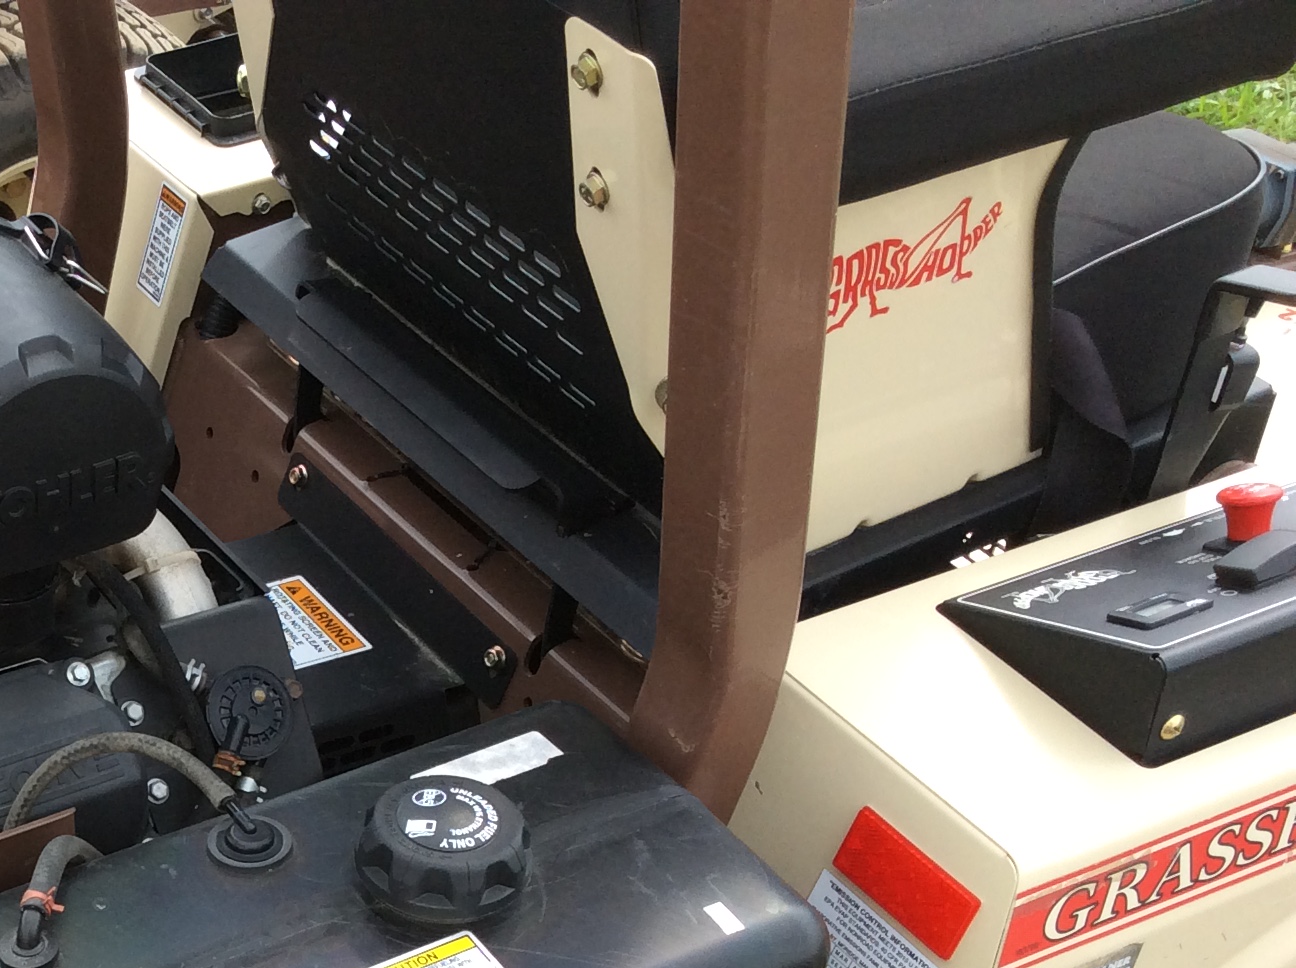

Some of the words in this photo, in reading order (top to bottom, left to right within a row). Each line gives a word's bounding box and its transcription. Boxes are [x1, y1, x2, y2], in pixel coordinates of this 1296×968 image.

[269, 587, 302, 615] ROTATING
[296, 614, 326, 639] SCREEN
[319, 638, 339, 652] AND
[279, 610, 293, 620] DO
[287, 619, 305, 633] NOT
[300, 632, 325, 653] CLEAN
[296, 594, 357, 647] WARNING
[449, 787, 499, 822] UNLEADED
[439, 836, 476, 849] ONLY
[473, 821, 498, 843] FUEL
[822, 894, 836, 908] EPA
[835, 896, 849, 911] THIS
[847, 907, 879, 937] EQUIPMENT
[877, 933, 897, 953] MEETS
[835, 915, 848, 929] FOR
[846, 925, 874, 952] NONROAD
[858, 907, 891, 937] CONTROL
[833, 948, 849, 964] MAR
